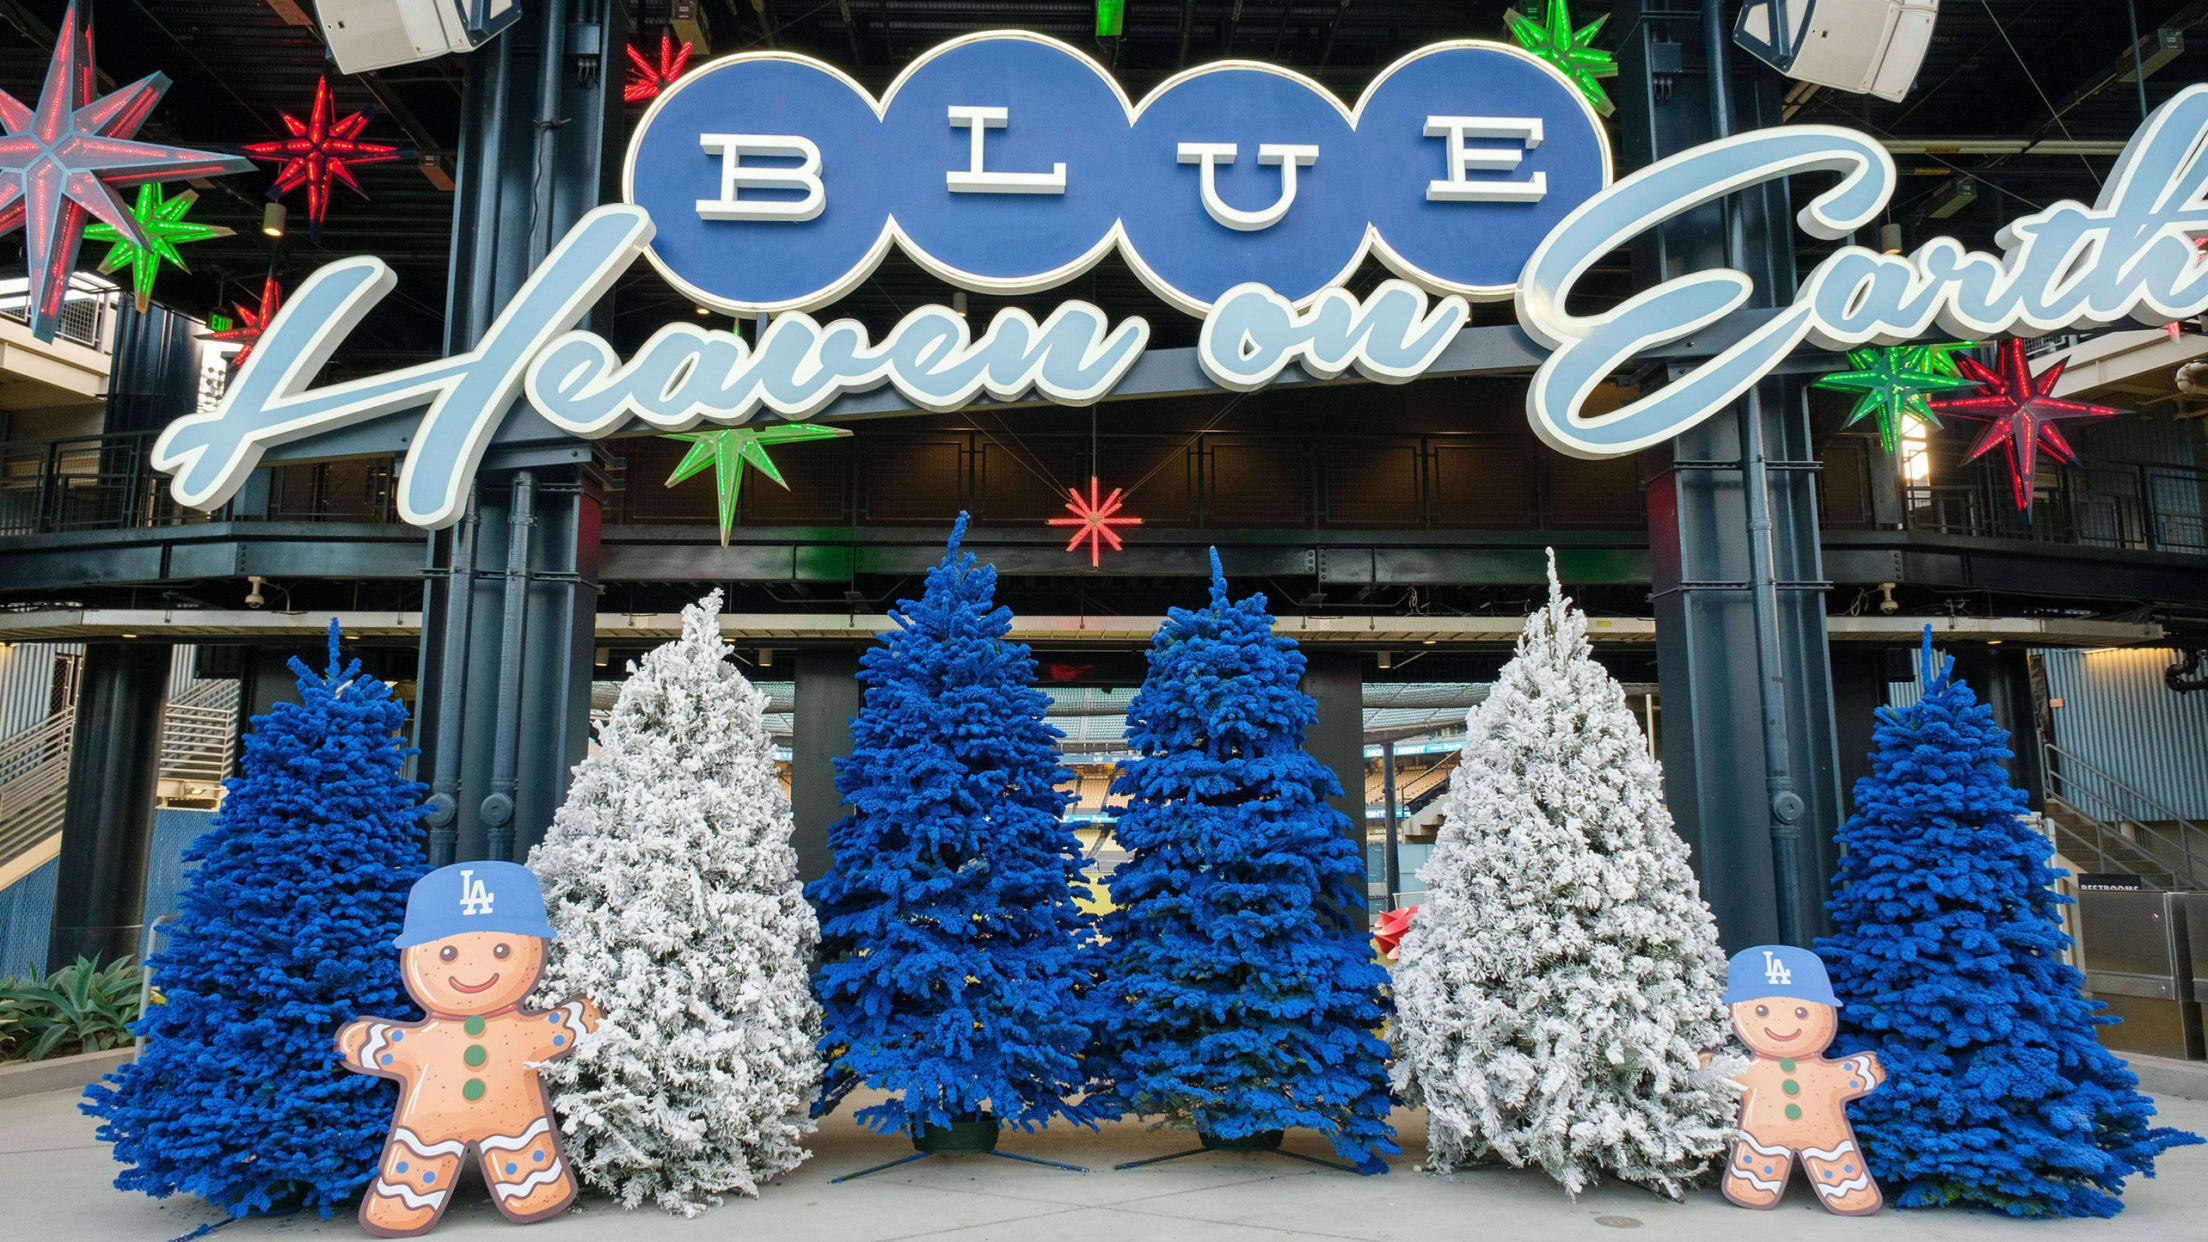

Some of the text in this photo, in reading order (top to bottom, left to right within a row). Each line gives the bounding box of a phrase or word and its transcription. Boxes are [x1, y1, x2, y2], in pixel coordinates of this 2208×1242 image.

[695, 105, 1547, 232] BLUE
[150, 83, 2208, 529] Heaven on Earth
[459, 869, 495, 916] LA
[1762, 950, 1792, 985] LA
